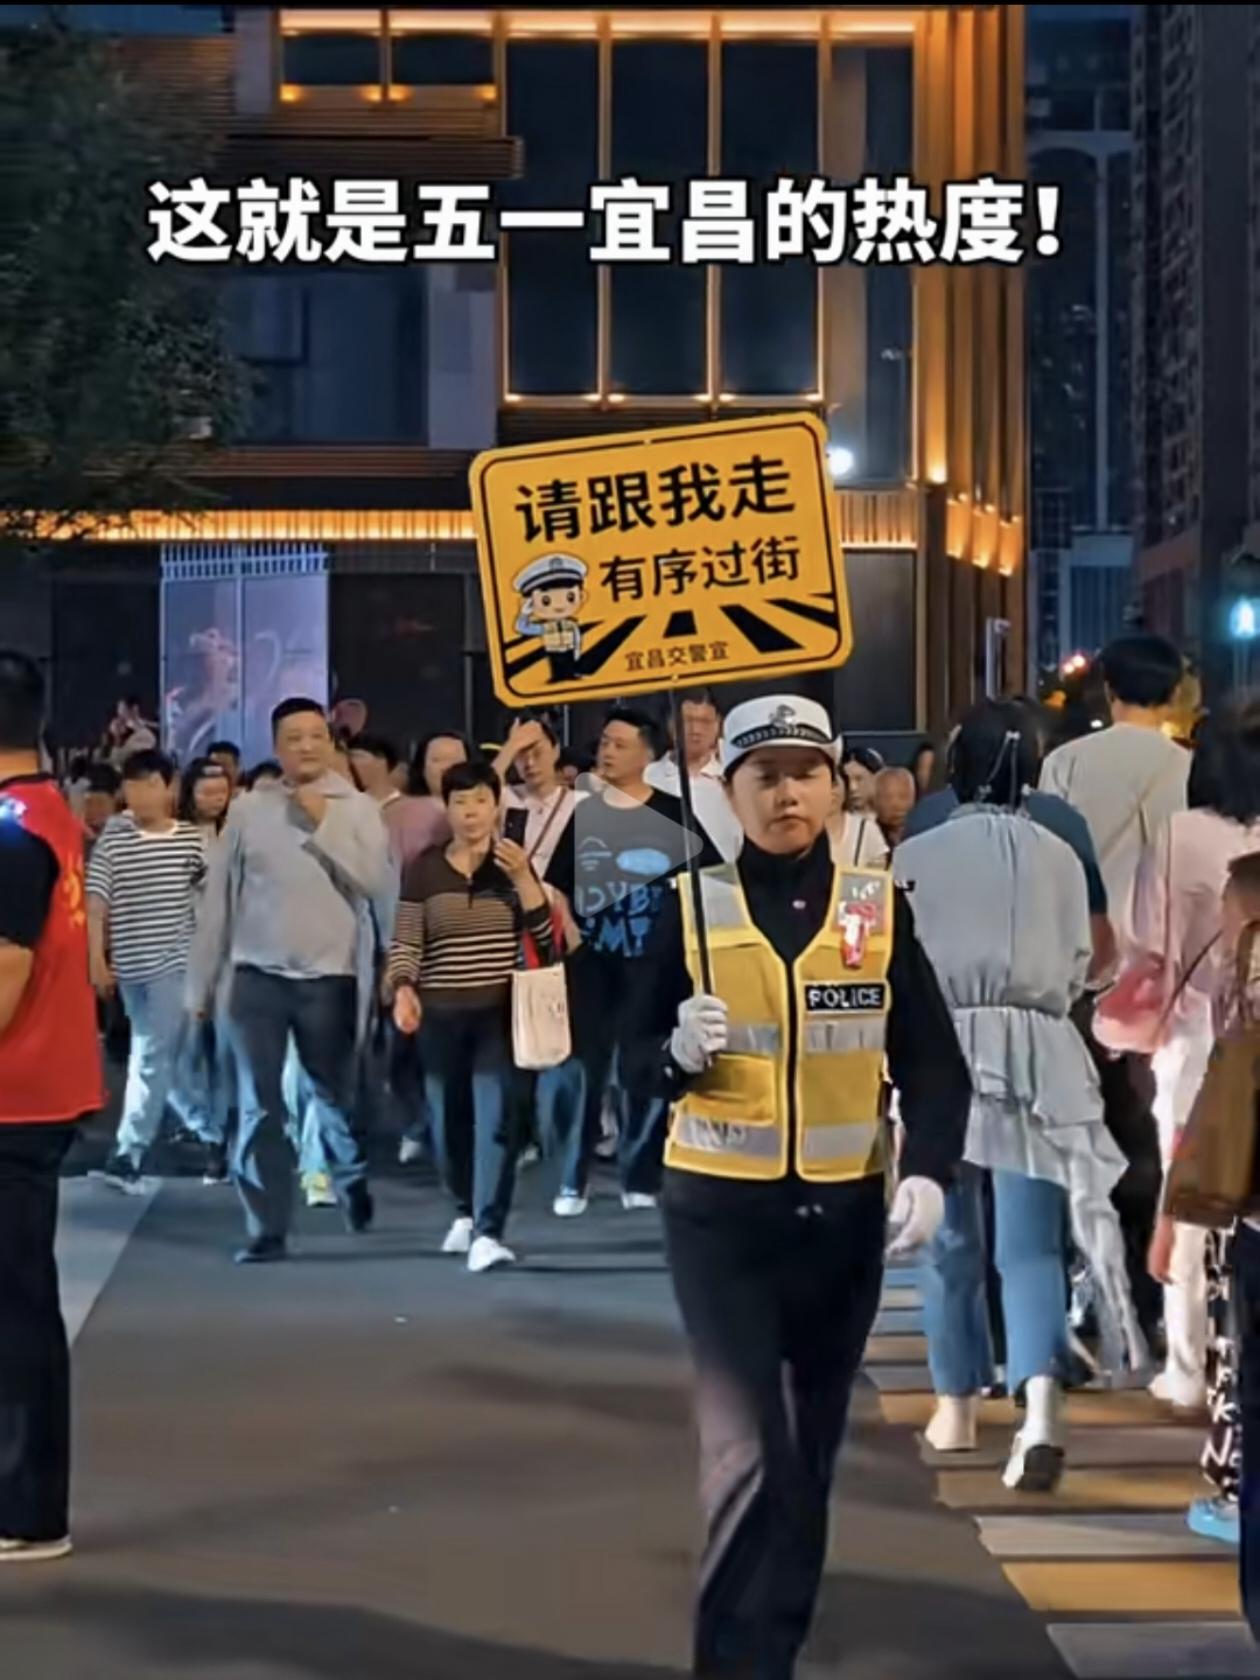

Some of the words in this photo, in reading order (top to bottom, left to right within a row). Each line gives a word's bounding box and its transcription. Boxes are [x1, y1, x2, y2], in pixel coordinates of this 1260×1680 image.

[515, 455, 796, 542] 请跟我走
[600, 536, 800, 602] 有序过街
[808, 987, 881, 1008] POLICE
